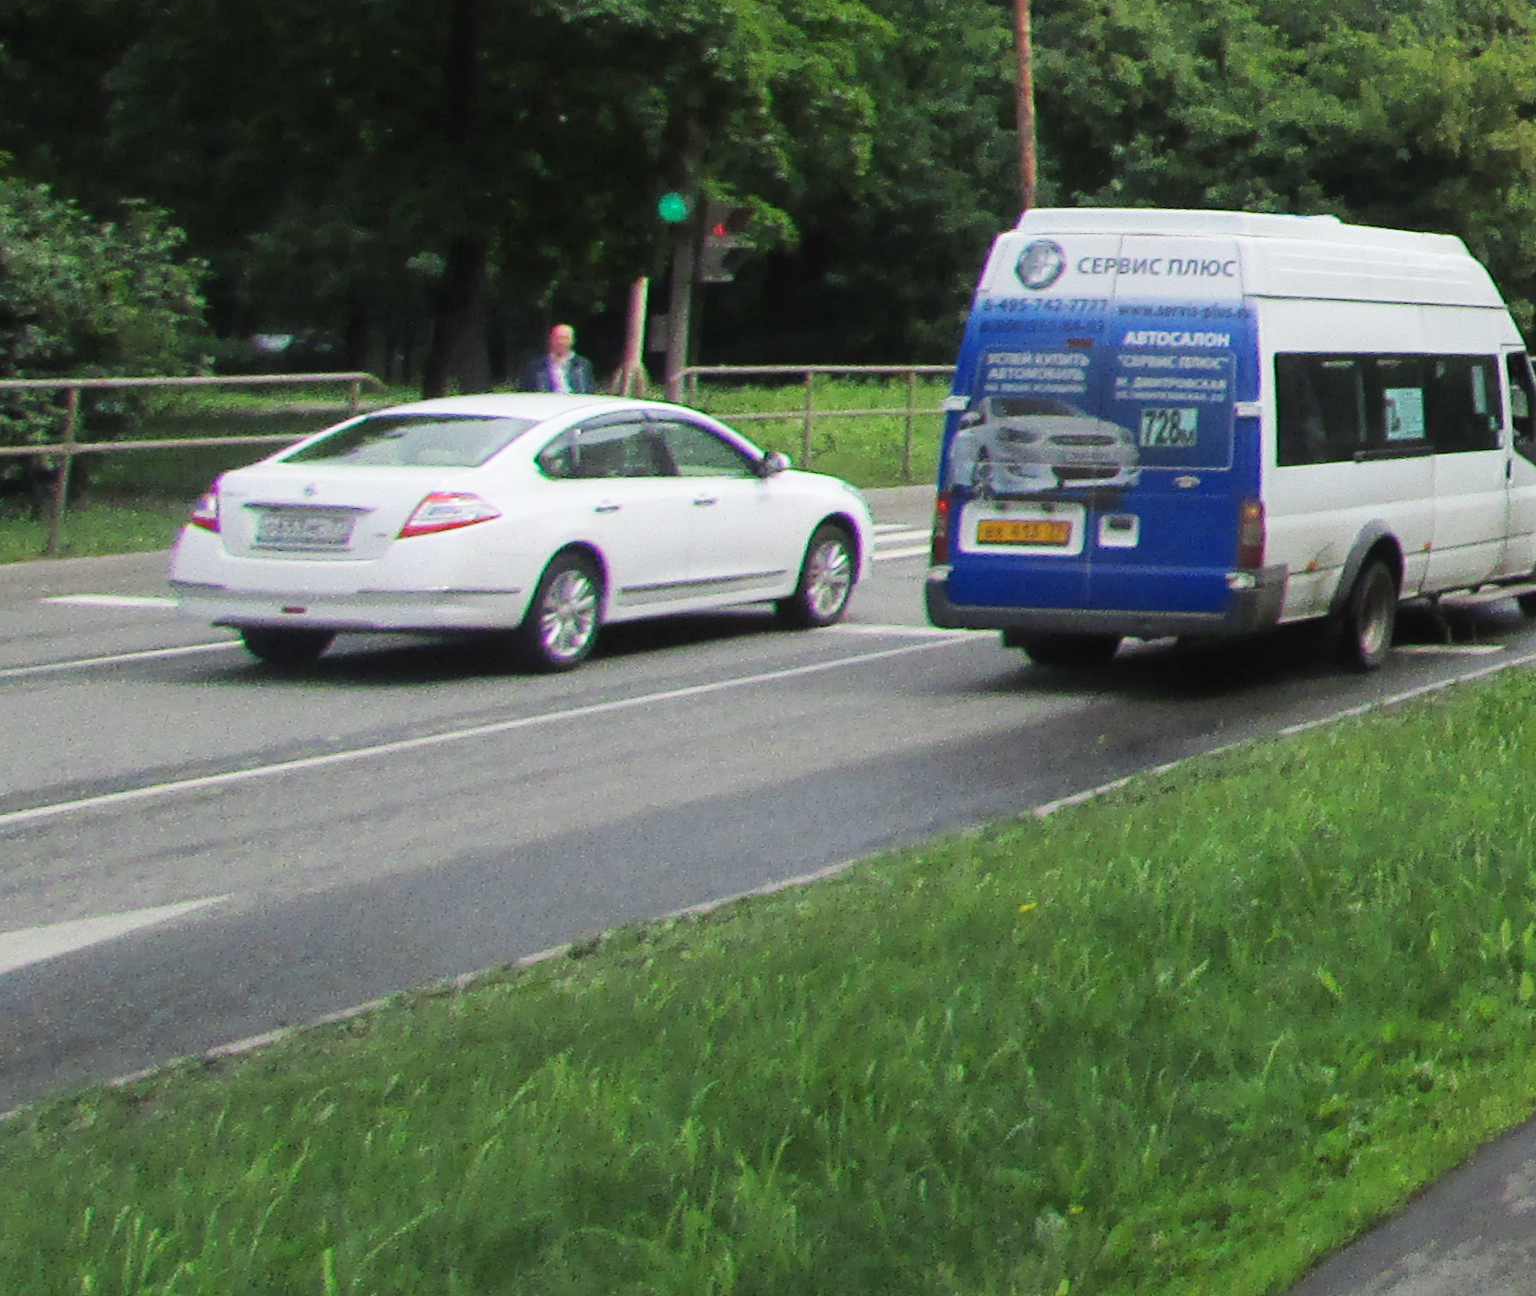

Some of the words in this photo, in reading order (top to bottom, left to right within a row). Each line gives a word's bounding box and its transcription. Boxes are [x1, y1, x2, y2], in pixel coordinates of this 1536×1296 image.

[1078, 257, 1161, 276] СЕРВИС
[1167, 259, 1237, 277] ПЛЮС
[1124, 330, 1231, 347] АВТОСАЛОН
[1141, 410, 1181, 445] 728
